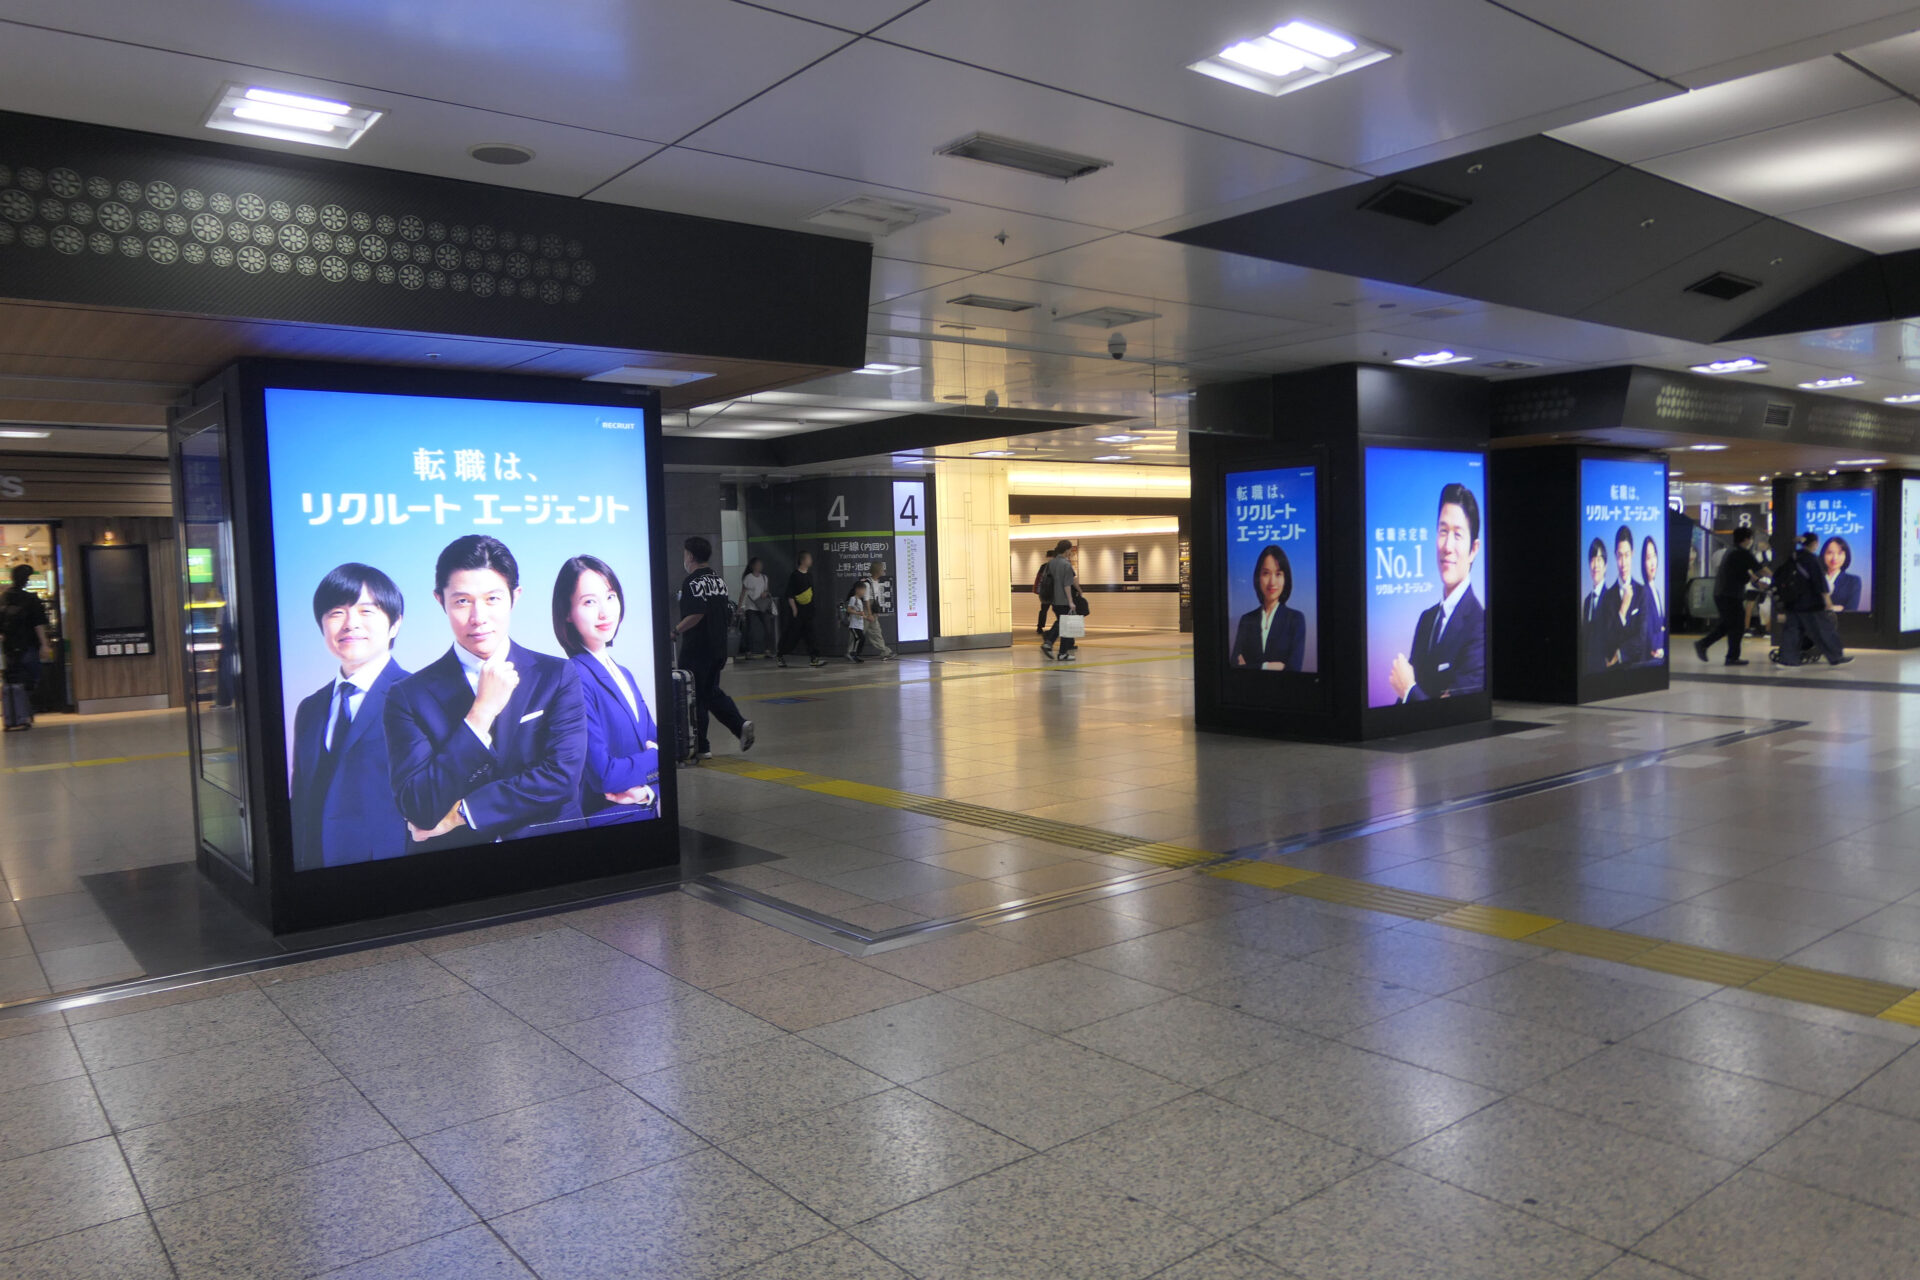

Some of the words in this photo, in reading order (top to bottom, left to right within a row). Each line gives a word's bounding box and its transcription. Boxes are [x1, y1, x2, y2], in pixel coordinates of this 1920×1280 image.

[602, 422, 635, 430] RECRUIT
[412, 447, 538, 482] 転職は、
[302, 493, 461, 525] リクルート
[473, 494, 630, 525] エージェント
[827, 495, 849, 528] 4
[900, 494, 918, 526] 4
[1236, 503, 1297, 522] リクルート
[1738, 512, 1752, 528] 8
[1806, 510, 1857, 523] リクルート
[1237, 523, 1307, 542] エージェント
[1375, 544, 1424, 579] No.1
